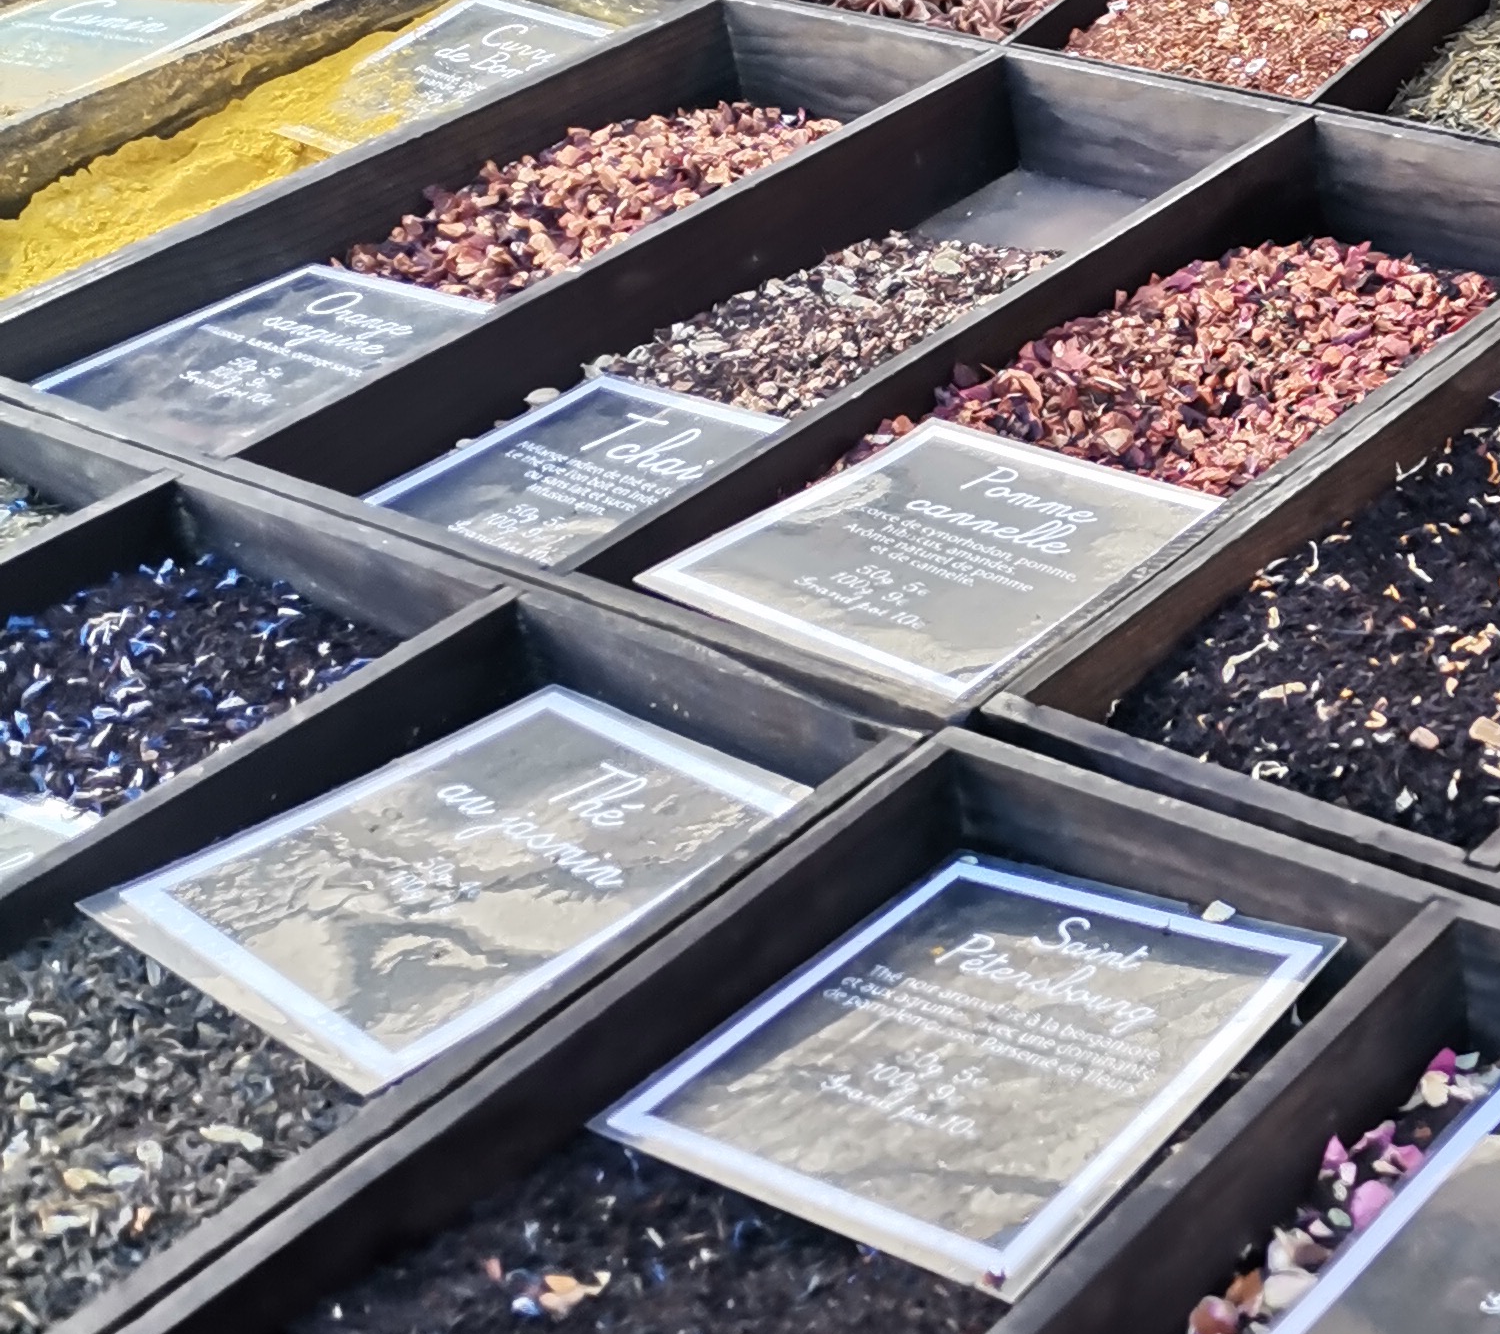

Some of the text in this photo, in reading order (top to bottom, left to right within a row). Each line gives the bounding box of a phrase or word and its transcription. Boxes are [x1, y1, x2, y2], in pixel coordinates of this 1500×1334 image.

[434, 43, 472, 63] de
[481, 23, 557, 72] Curry
[262, 316, 385, 355] sanguine
[306, 291, 414, 340] Orange
[580, 412, 716, 481] Tchai
[604, 470, 621, 481] de
[613, 484, 630, 495] en
[960, 466, 1098, 523] Pomme
[881, 523, 943, 552] hibiscus,
[900, 516, 1079, 584] de cynorhodon, pomme,
[905, 499, 1072, 554] cannelle
[843, 522, 1035, 593] Arôme naturel de pomme
[870, 543, 975, 588] et de cannelle.
[902, 581, 932, 598] 5€
[549, 761, 648, 827] Thé
[436, 784, 624, 889] au jasmin
[1031, 915, 1152, 971] Saint
[841, 975, 1056, 1049] et aux une
[870, 963, 1062, 1034] Thé noir à la
[934, 932, 1162, 1037] Pétersbourg
[823, 986, 1084, 1078] de de
